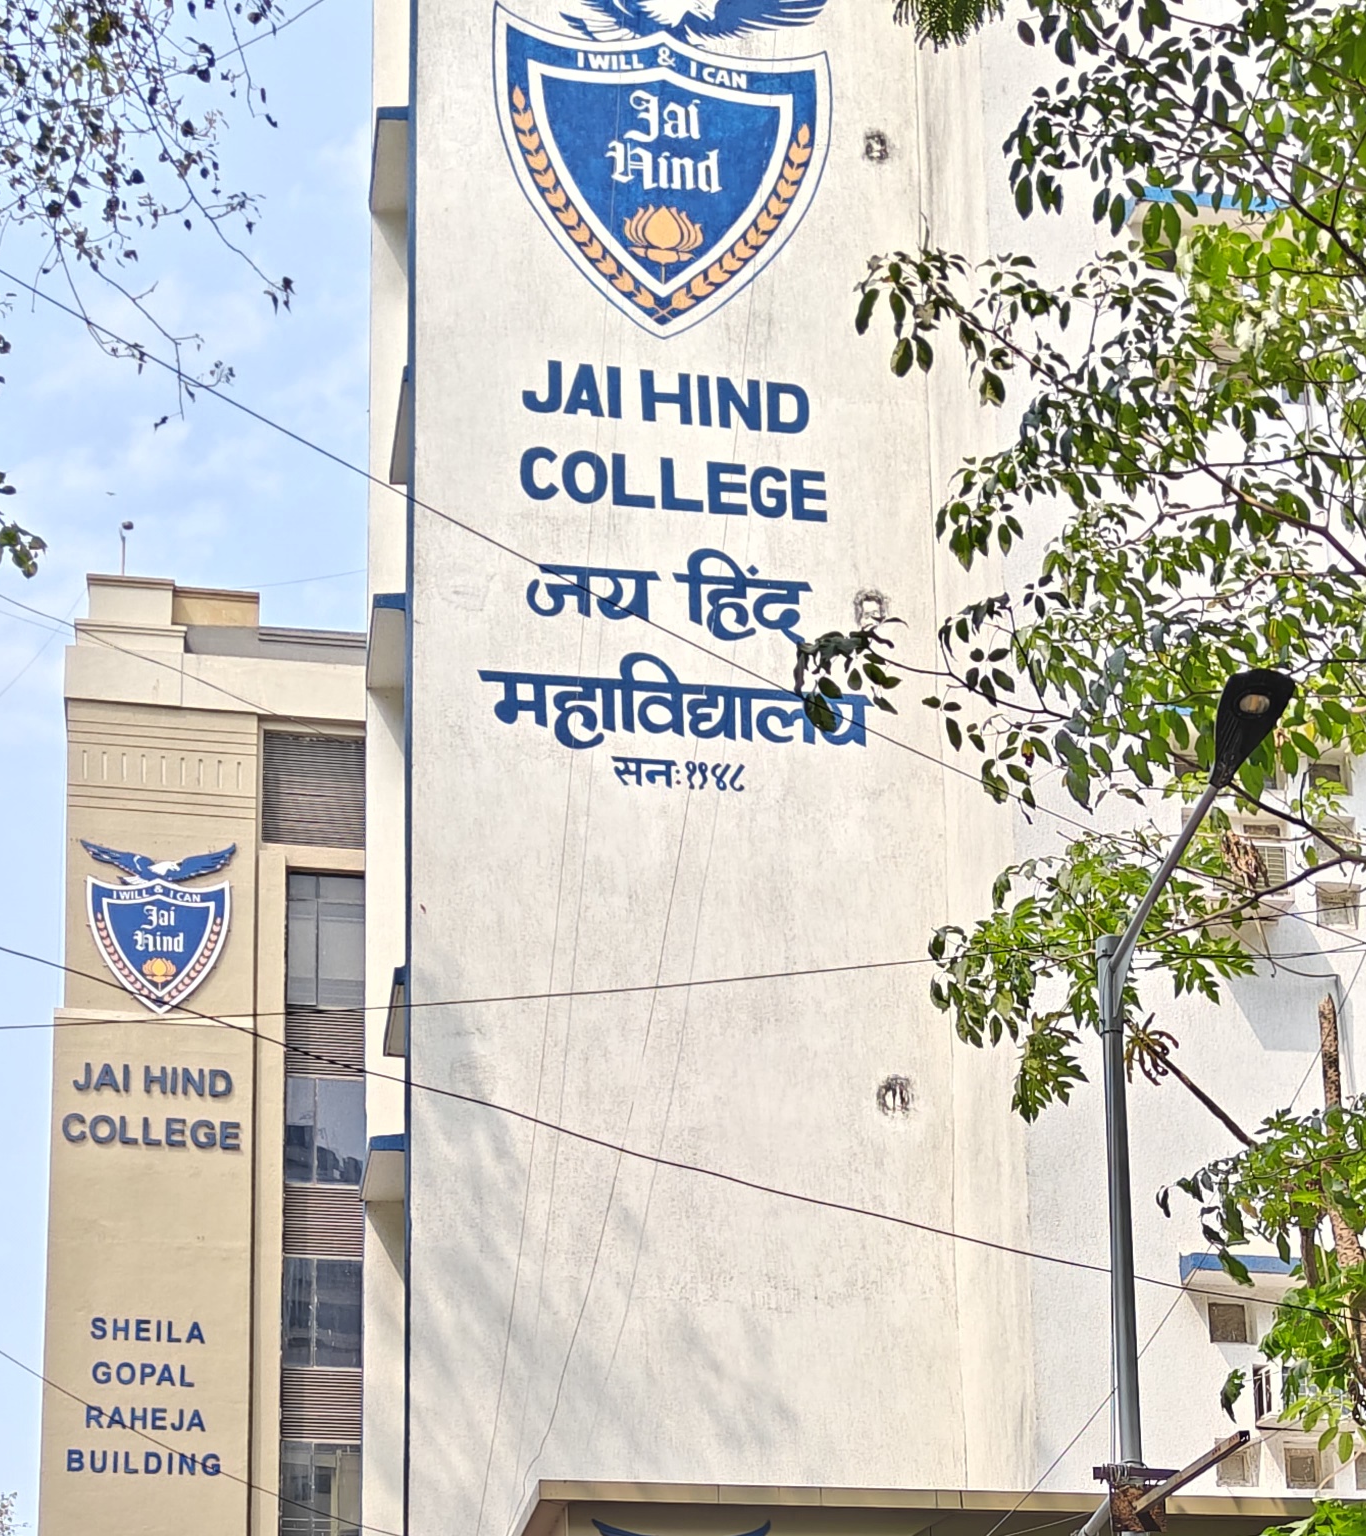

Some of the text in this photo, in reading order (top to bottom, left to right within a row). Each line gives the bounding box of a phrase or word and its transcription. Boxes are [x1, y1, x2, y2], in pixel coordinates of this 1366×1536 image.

[578, 46, 747, 90] I WILL & I CAN
[624, 89, 700, 143] Jai
[605, 139, 723, 194] Hind
[522, 360, 810, 434] JAI HIND
[519, 446, 828, 522] COLLEGE
[526, 547, 813, 643] जय हिंद
[477, 651, 875, 750] महाविद्यालय
[119, 888, 149, 901] WILL
[154, 885, 164, 896] &
[176, 891, 202, 903] CAN
[142, 905, 176, 930] Jai
[133, 930, 185, 953] Hind
[73, 1062, 234, 1098] JAI HIND
[62, 1113, 242, 1151] COLLEGE
[90, 1317, 206, 1344] SHEILA
[91, 1361, 195, 1388] GOPAL
[85, 1405, 206, 1432] RAHEJA
[66, 1448, 221, 1477] BUILDING
